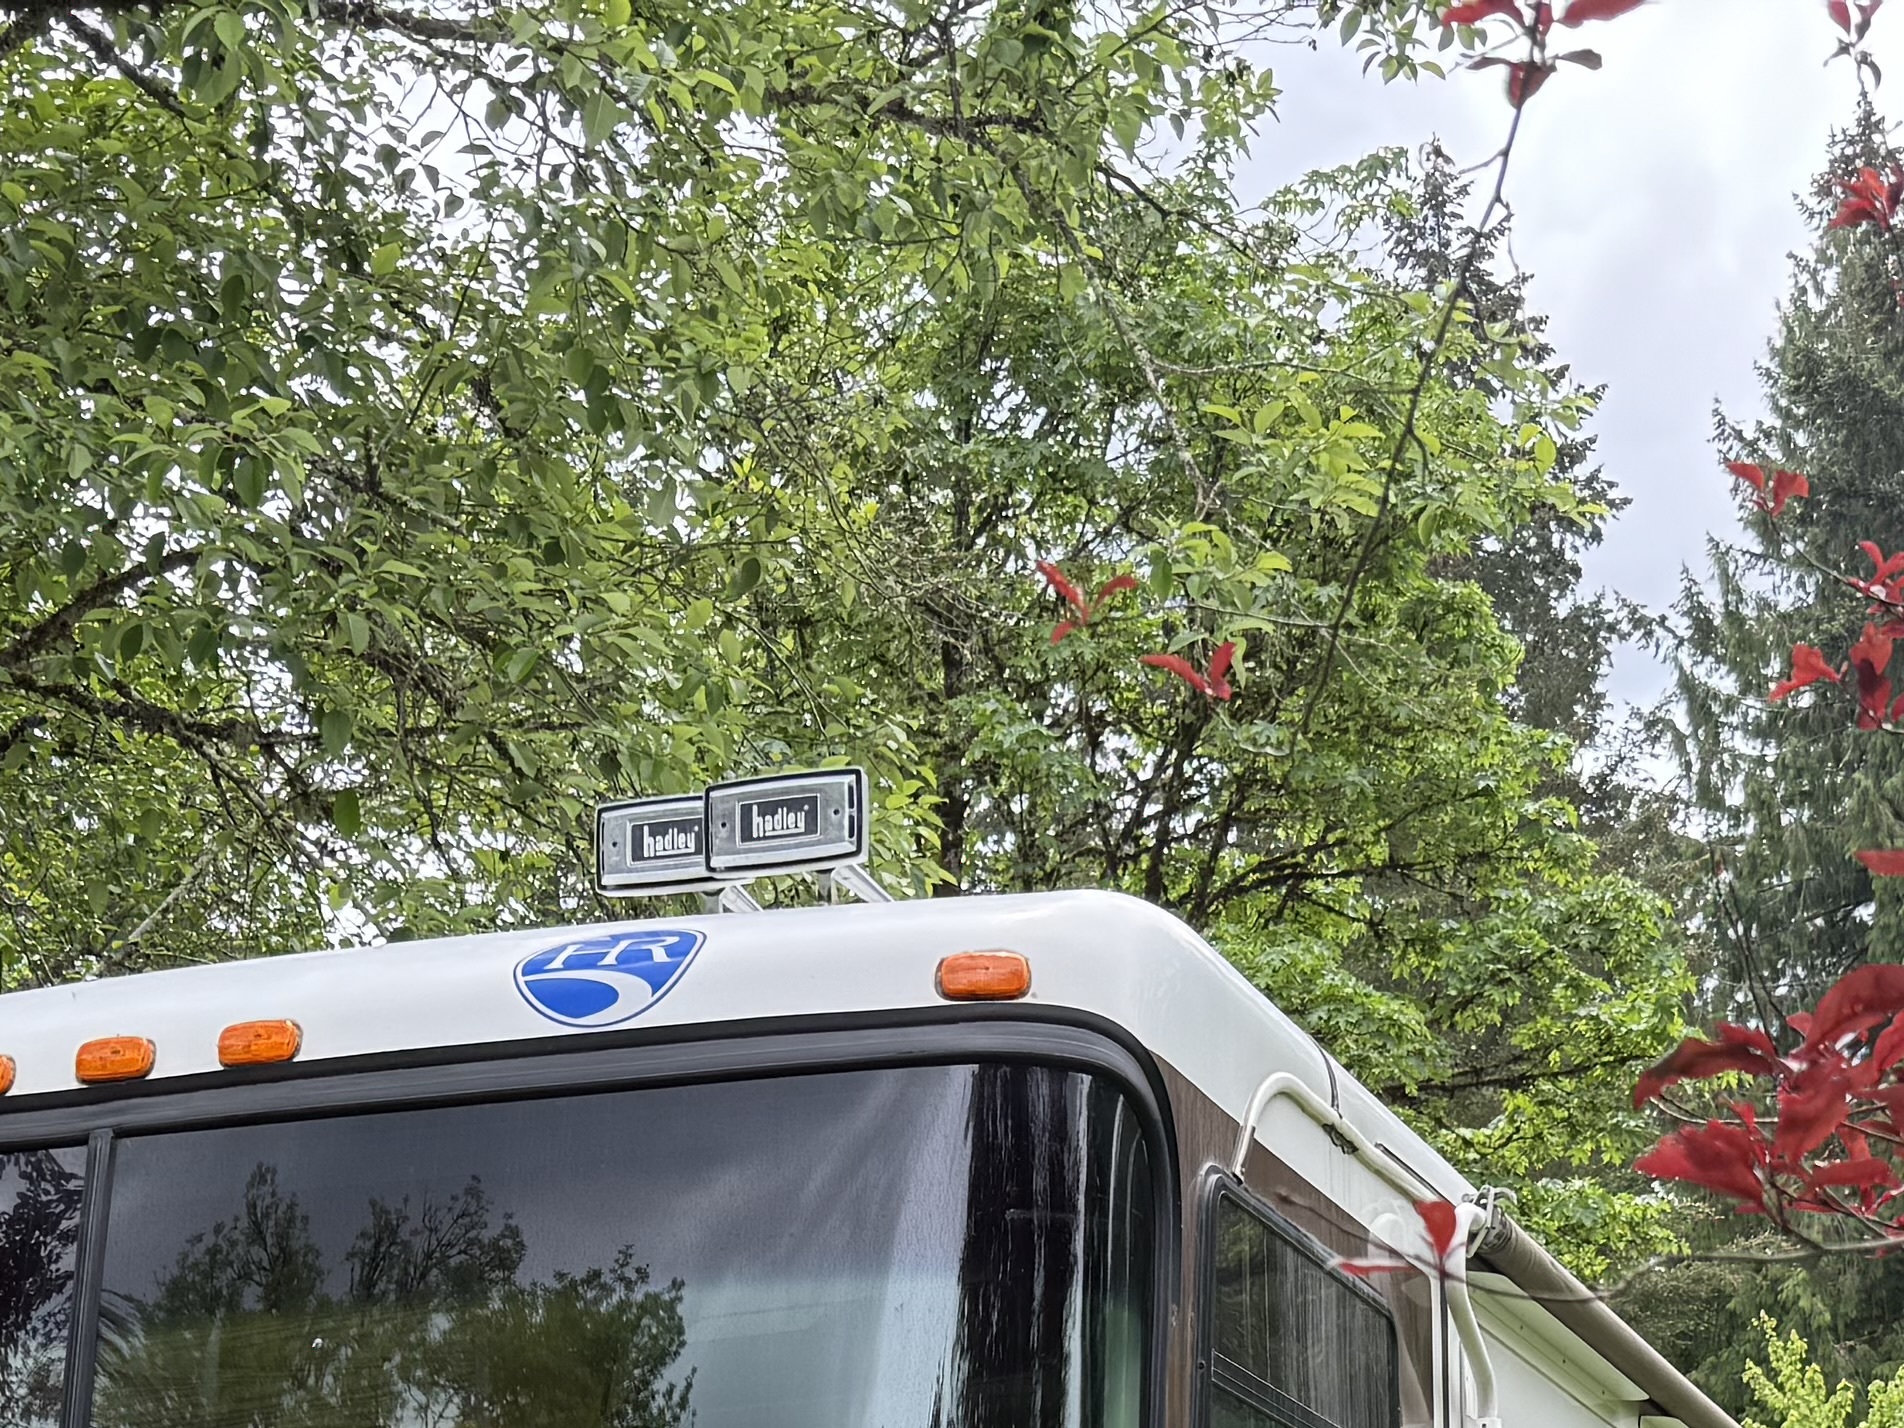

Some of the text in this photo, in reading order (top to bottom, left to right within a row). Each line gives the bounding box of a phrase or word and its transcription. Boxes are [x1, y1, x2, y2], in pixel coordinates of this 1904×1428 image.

[752, 804, 806, 839] hadley
[643, 825, 696, 858] hadley
[543, 936, 680, 970] HR
